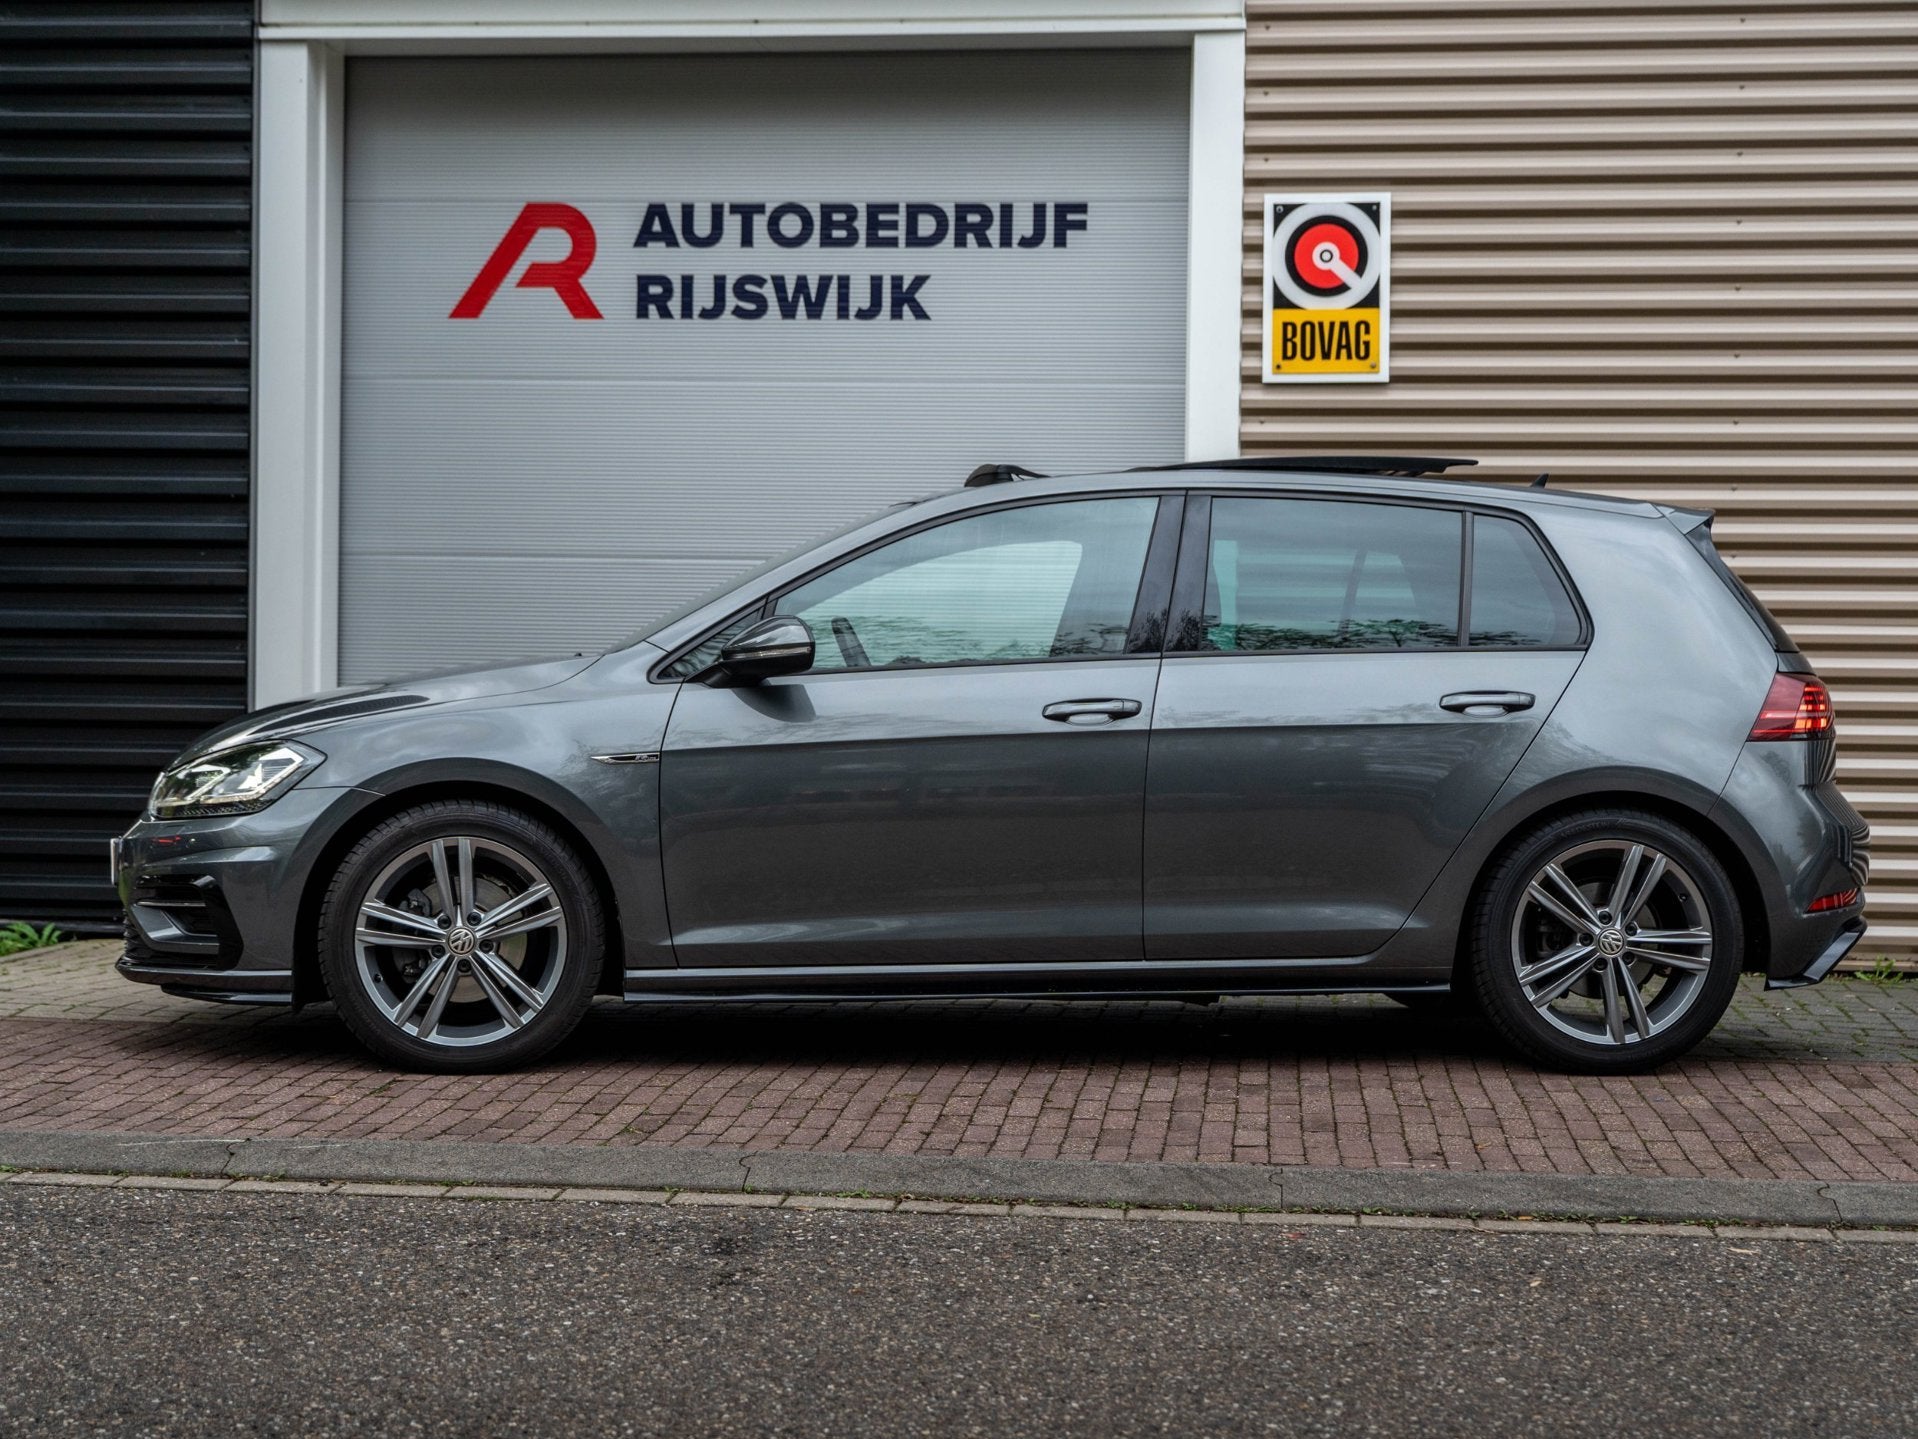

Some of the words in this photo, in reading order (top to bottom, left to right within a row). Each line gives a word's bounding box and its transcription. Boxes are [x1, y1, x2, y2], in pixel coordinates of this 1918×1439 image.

[633, 202, 1088, 248] AUTOBEDRIJF
[635, 274, 932, 321] RIJSWIJK
[1281, 320, 1371, 361] BOVAG
